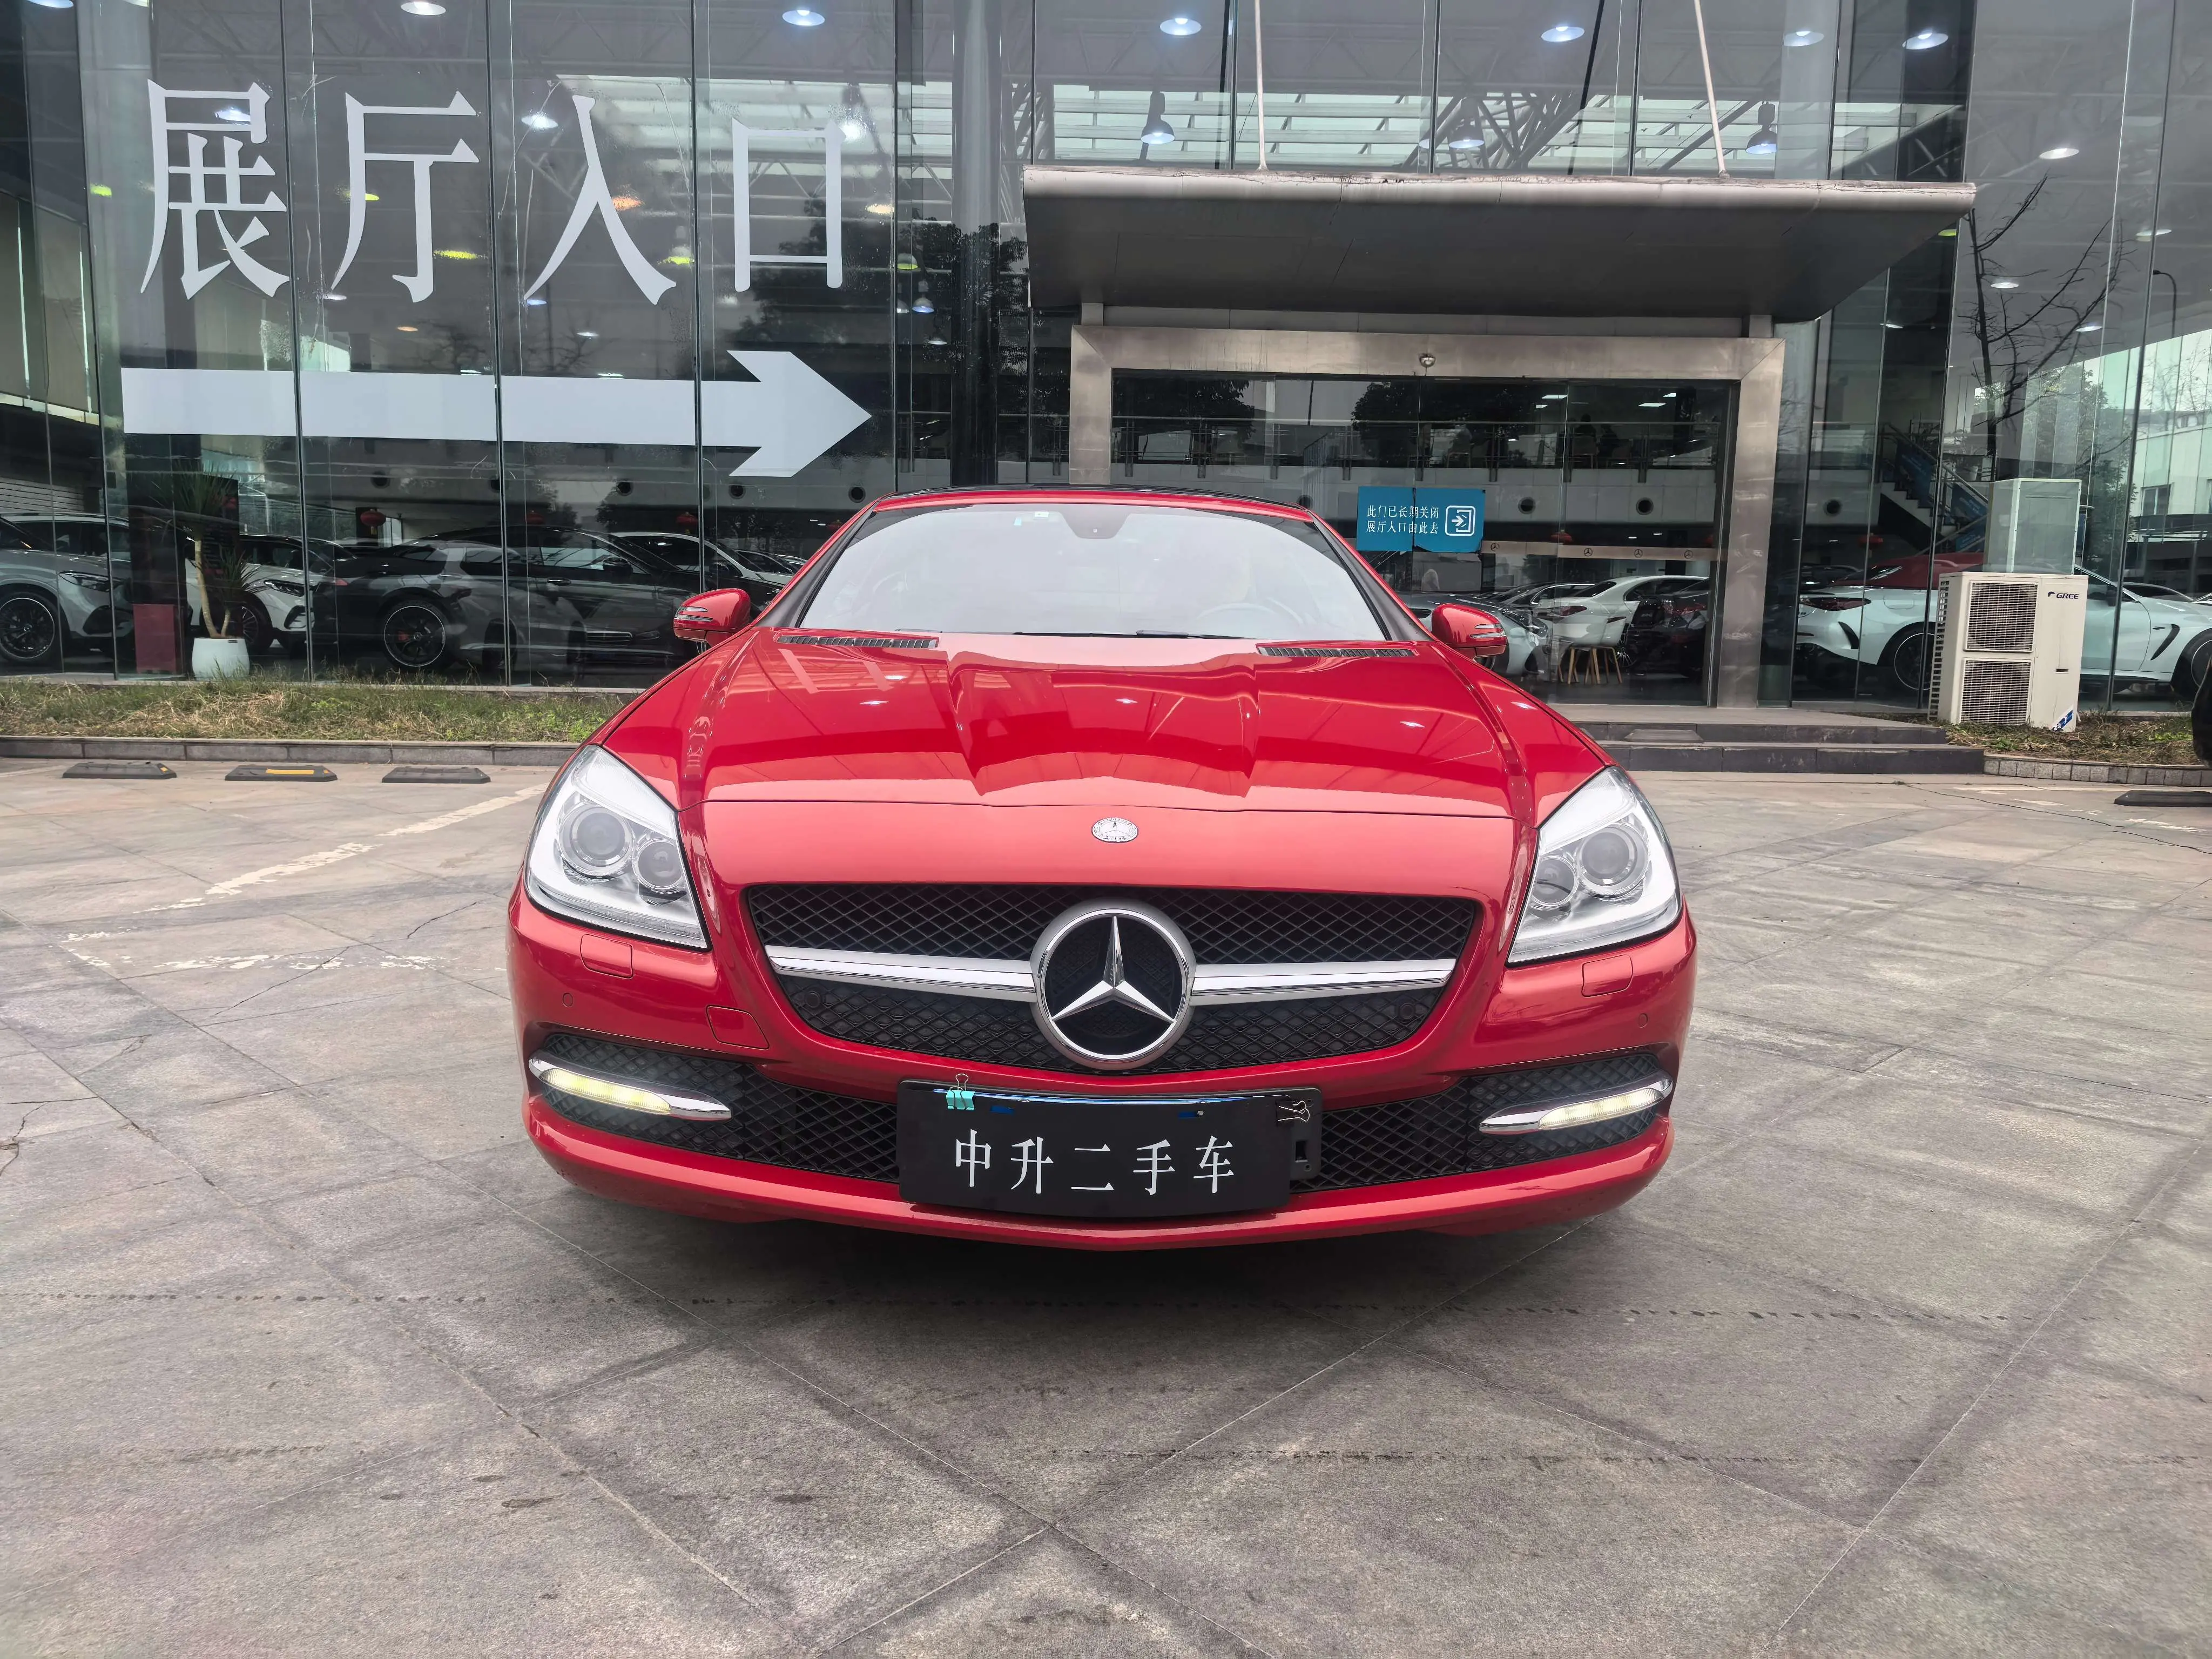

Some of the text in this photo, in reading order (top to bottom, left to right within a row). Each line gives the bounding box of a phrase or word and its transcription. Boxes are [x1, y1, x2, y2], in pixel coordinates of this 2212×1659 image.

[140, 78, 846, 305] 展厅入口
[1366, 520, 1439, 535] 展厅入口由此去
[1367, 505, 1439, 519] 此门已长期关闭
[955, 1129, 1235, 1196] 中升二手车
